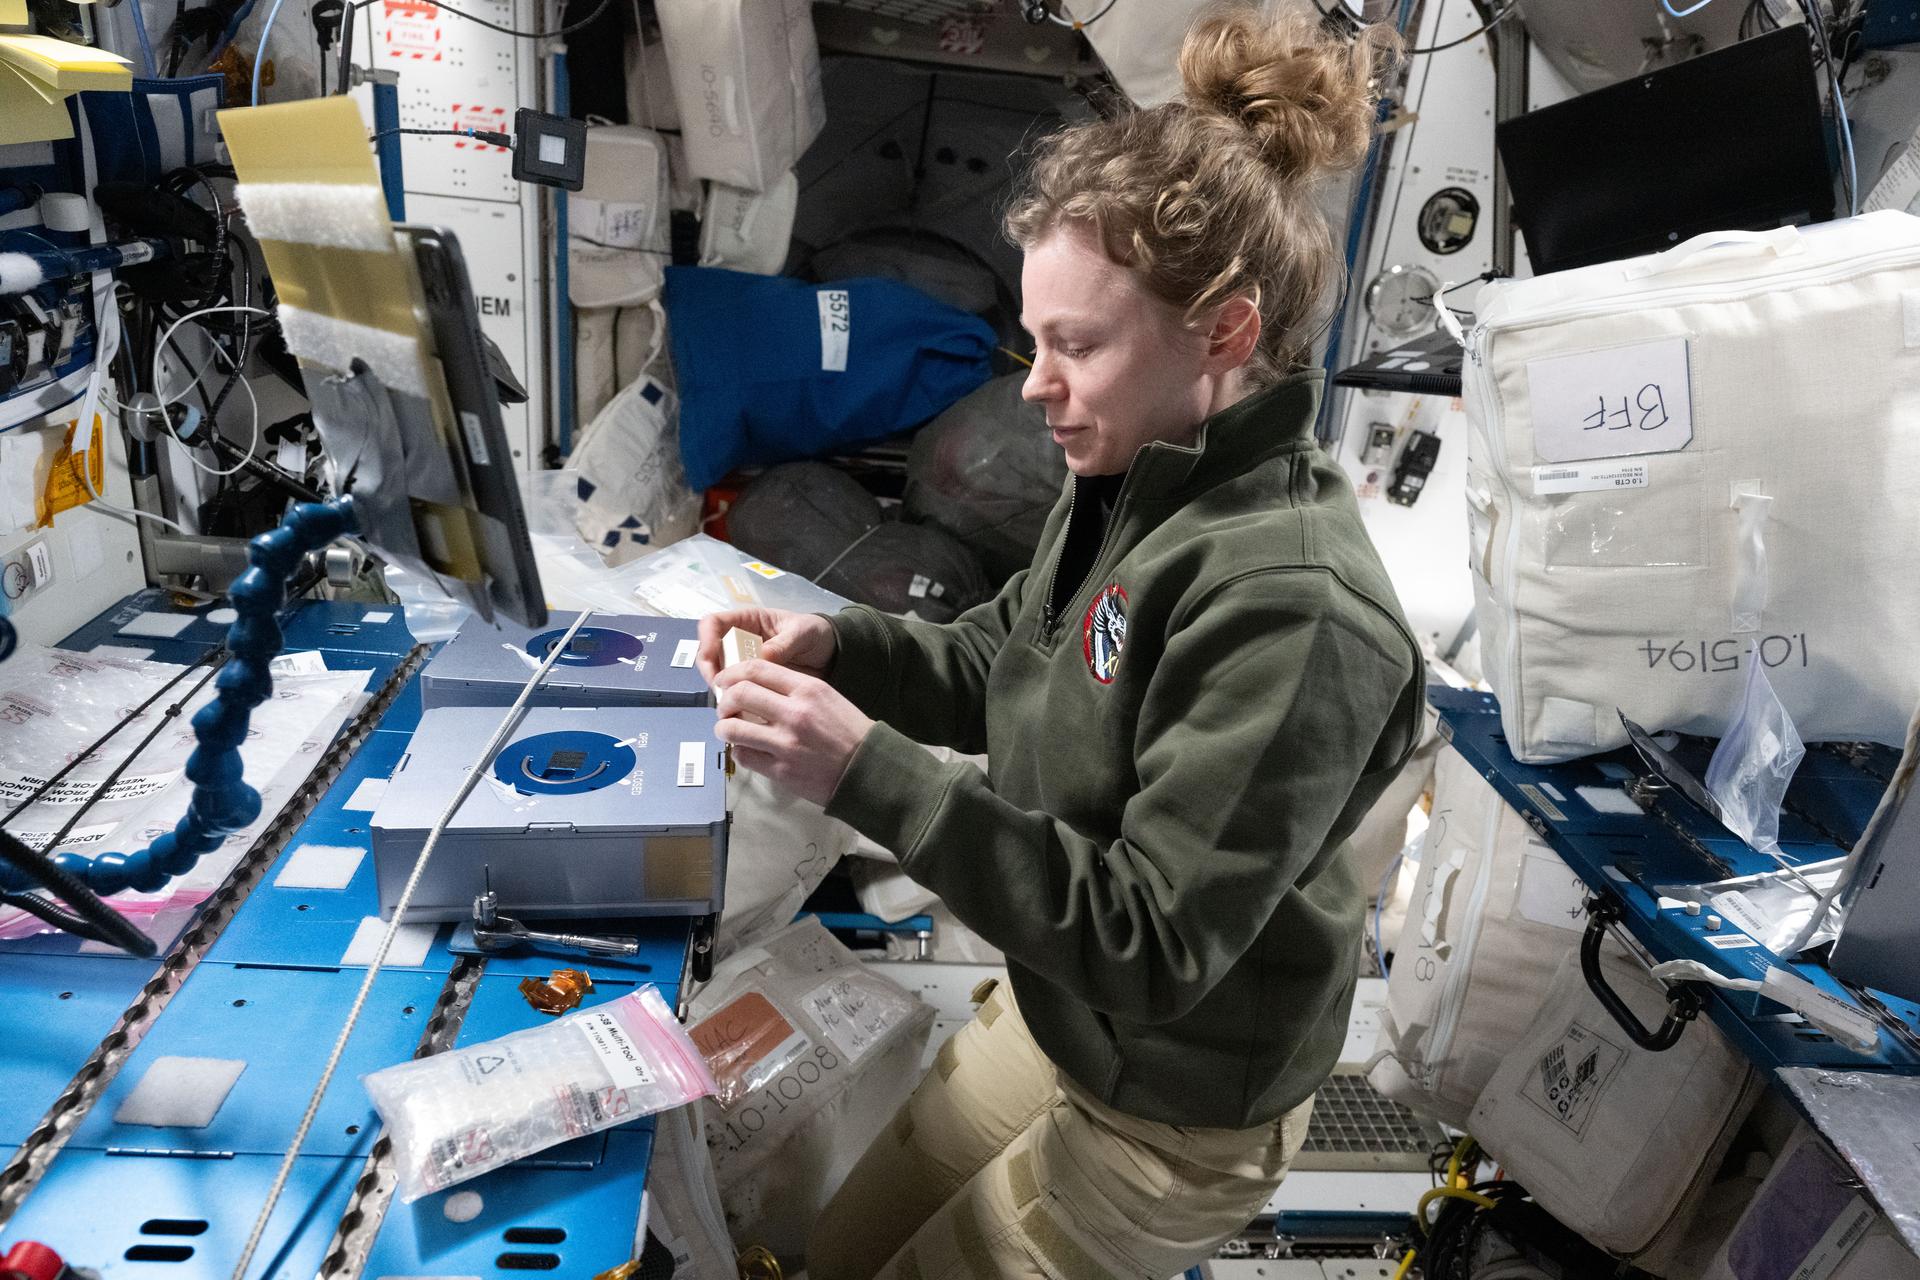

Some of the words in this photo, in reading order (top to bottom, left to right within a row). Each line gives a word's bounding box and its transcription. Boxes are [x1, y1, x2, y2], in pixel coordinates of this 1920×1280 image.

[829, 292, 849, 334] 5572
[1583, 384, 1669, 431] BFF
[1615, 478, 1631, 486] CTB
[646, 632, 658, 643] OPEN
[634, 655, 648, 672] CLOSED
[638, 732, 649, 748] OPEN
[631, 770, 645, 796] CLOSED
[120, 790, 148, 798] NOT
[607, 1027, 637, 1062] Multi-Tool
